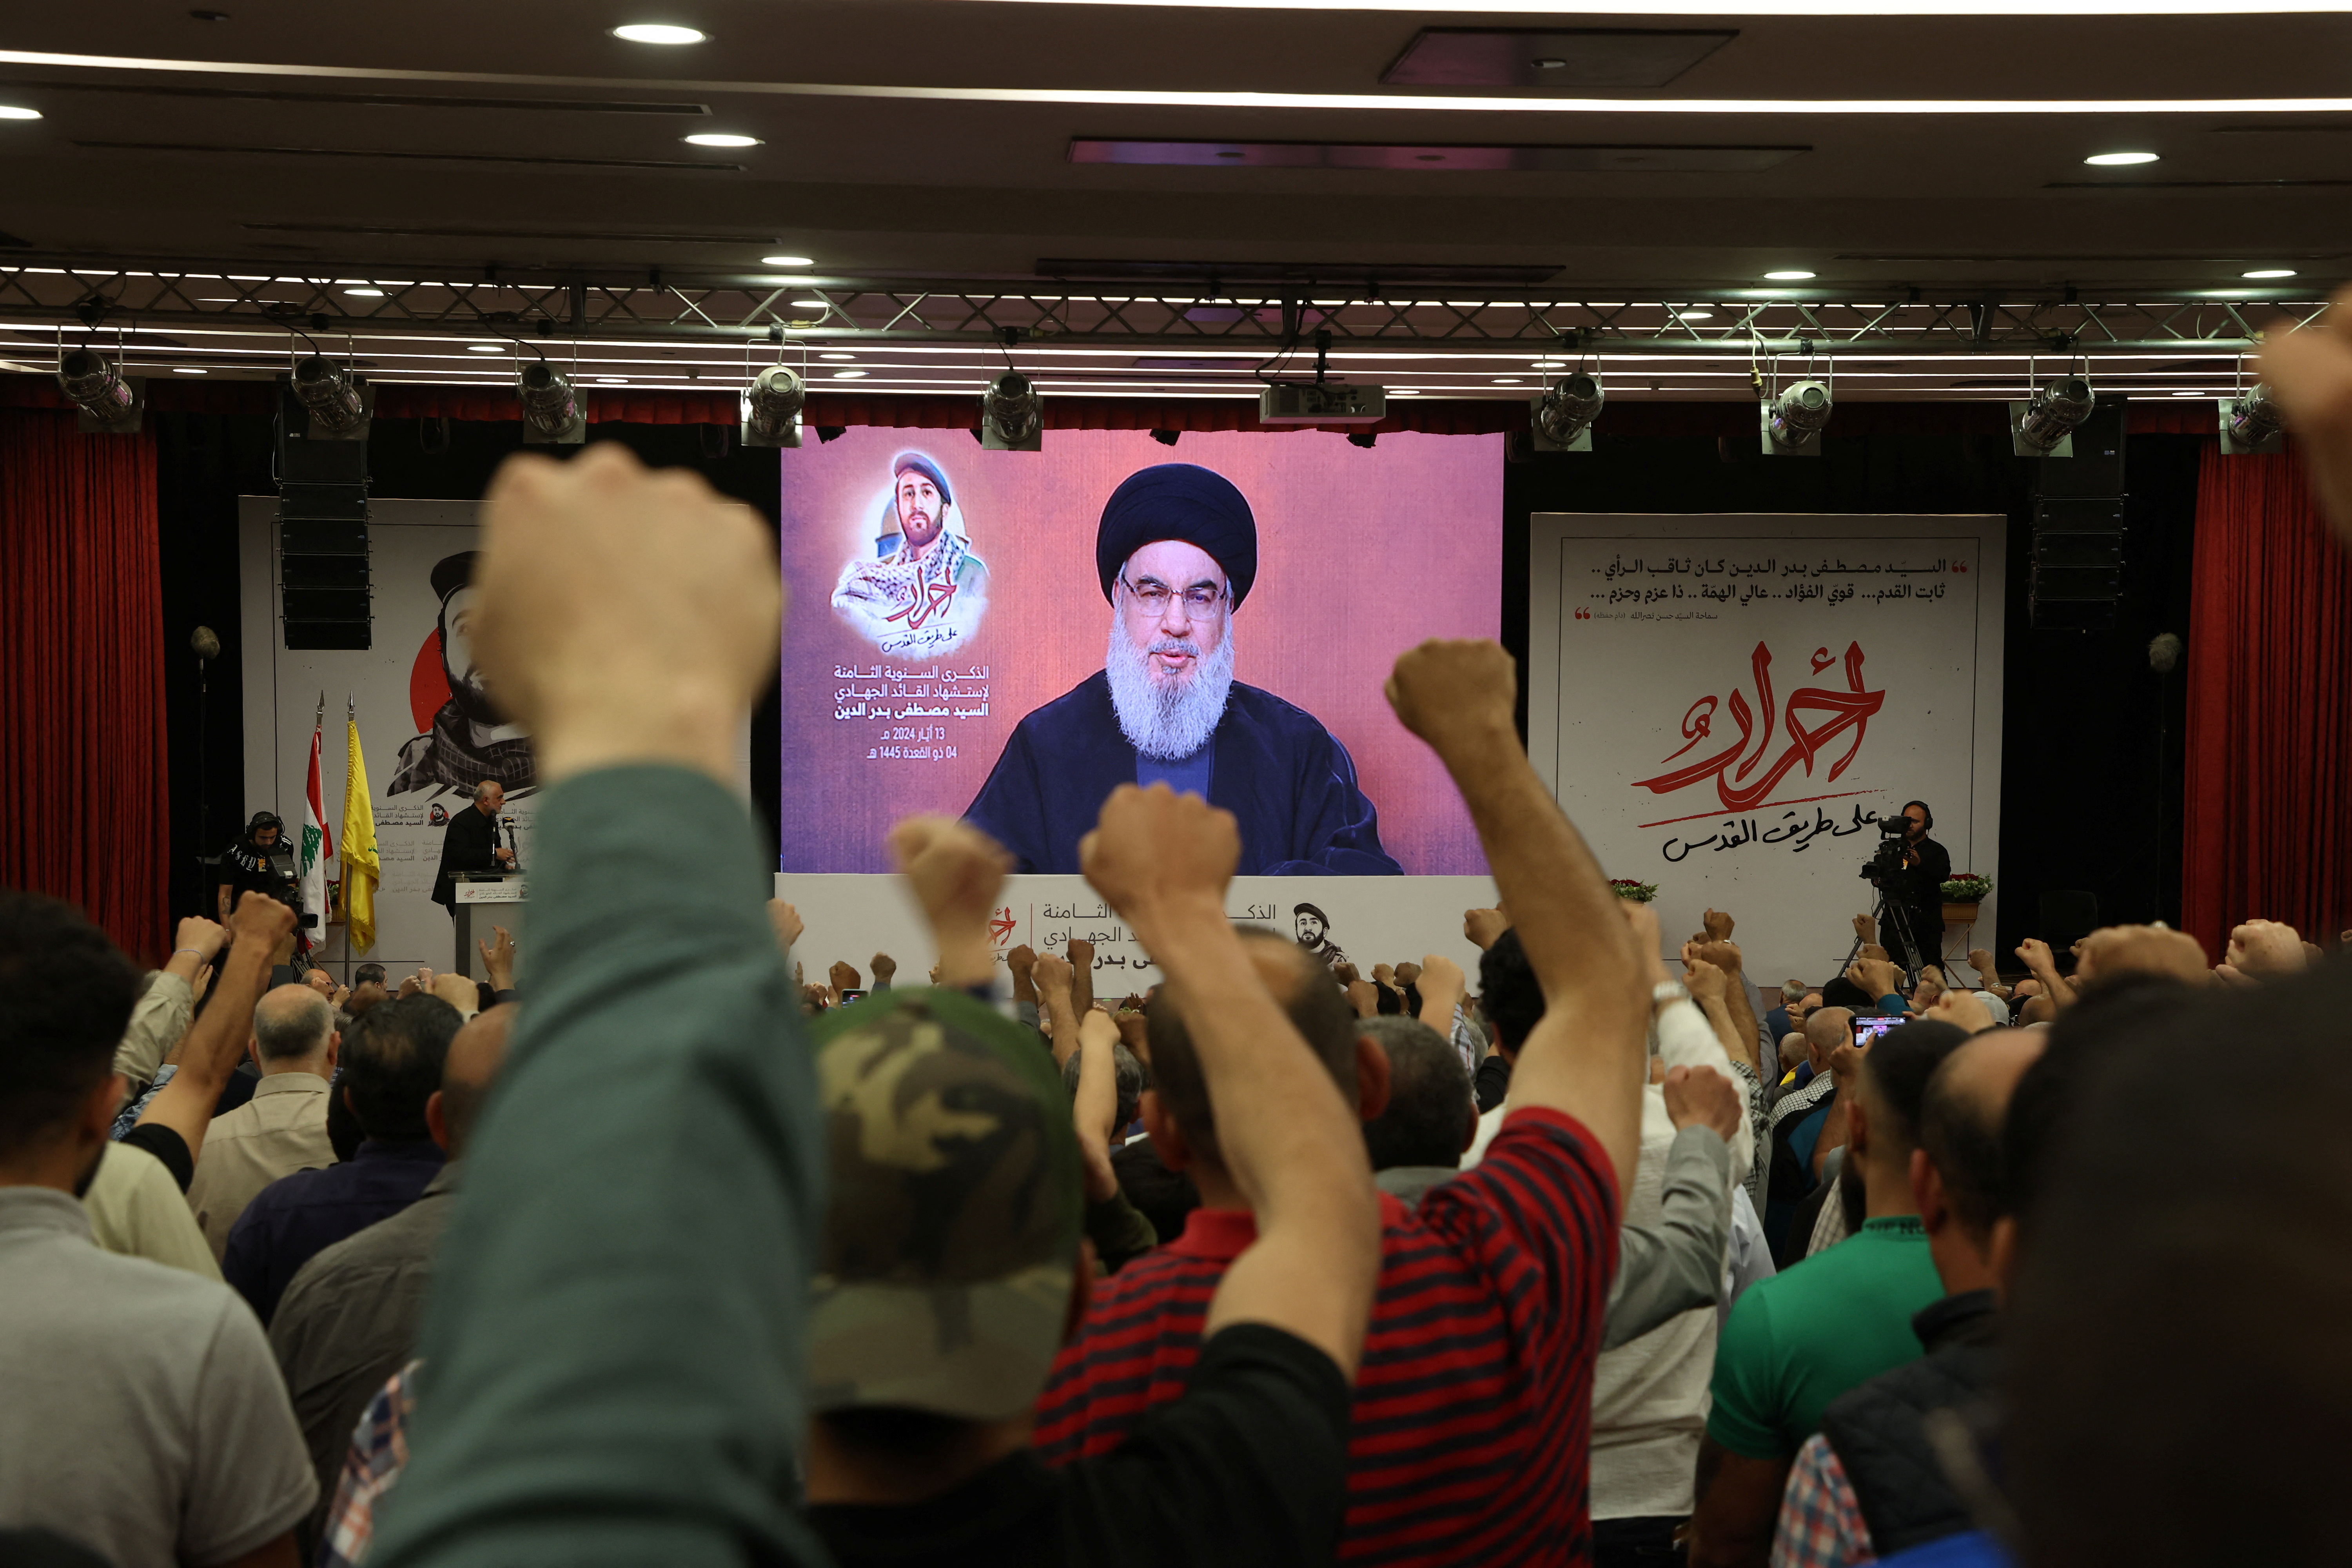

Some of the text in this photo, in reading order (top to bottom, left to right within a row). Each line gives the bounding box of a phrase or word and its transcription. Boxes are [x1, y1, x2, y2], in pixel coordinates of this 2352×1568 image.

[1604, 554, 1643, 581] الرأي
[1648, 557, 1691, 578] ثاقب
[1695, 559, 1725, 577] كان
[1730, 558, 1775, 578] الدين
[1781, 564, 1807, 578] بدر
[1811, 559, 1881, 577] مصطفى
[1609, 587, 1640, 604] وحزم
[1645, 587, 1668, 604] عزم
[1672, 584, 1684, 598] ذا
[1740, 584, 1769, 606] عالي
[1785, 584, 1823, 603] الفؤاد
[1916, 583, 1945, 603] ثابت
[1630, 612, 1654, 621] نصرالله
[882, 628, 957, 652] على طريق القدس
[834, 664, 989, 682] الذكرى السنوية الثامنة
[834, 683, 989, 703] لإستشهاد القائد الجهادي
[834, 702, 989, 720] السيد مصطفى بدر الدين
[893, 727, 915, 740] 2024
[935, 727, 945, 740] 13
[879, 746, 900, 759] 1445
[902, 746, 931, 759] القعدة
[933, 746, 944, 761] ذو
[946, 746, 957, 759] 04
[1663, 804, 1878, 862] على طريق القدس
[1043, 903, 1112, 919] الثامنة
[1093, 955, 1125, 970] بدر
